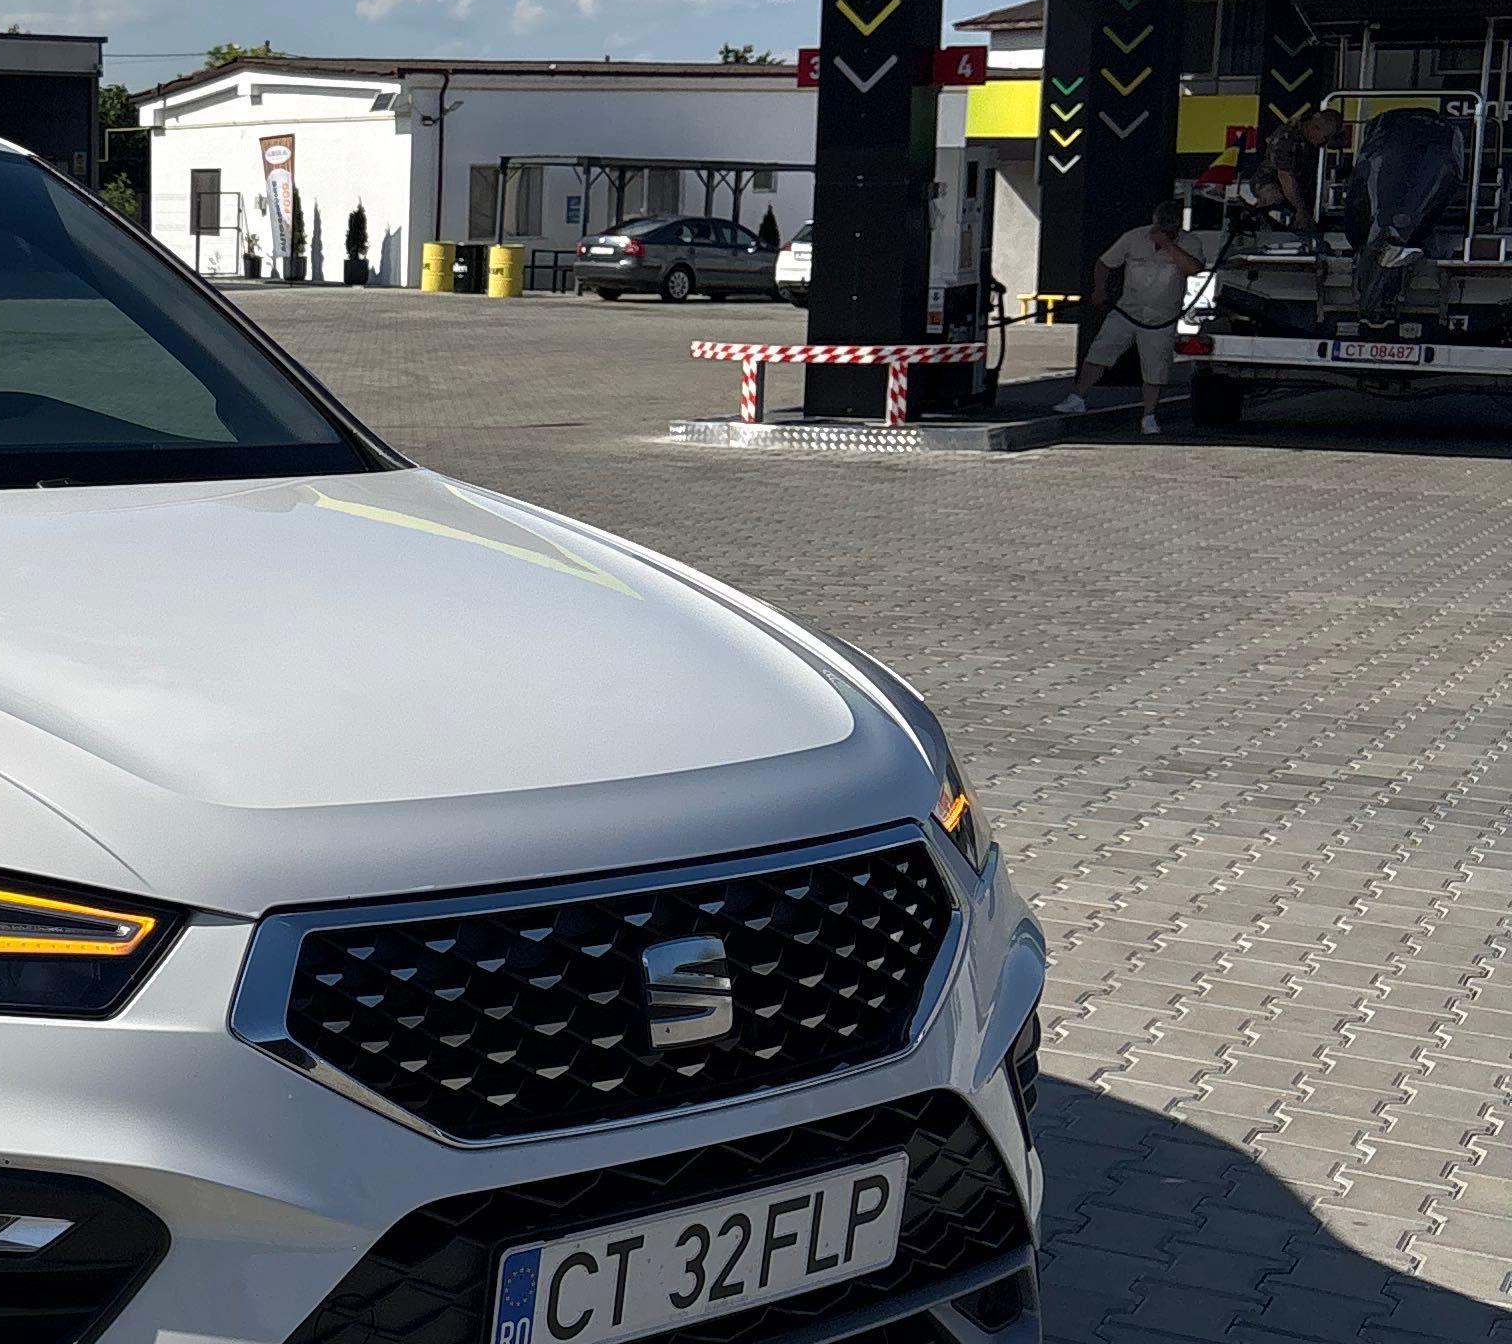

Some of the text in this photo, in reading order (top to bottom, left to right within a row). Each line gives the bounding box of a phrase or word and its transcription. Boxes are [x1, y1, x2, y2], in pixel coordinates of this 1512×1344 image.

[957, 54, 973, 79] 4
[1345, 343, 1366, 357] CT
[546, 1235, 645, 1341] CT
